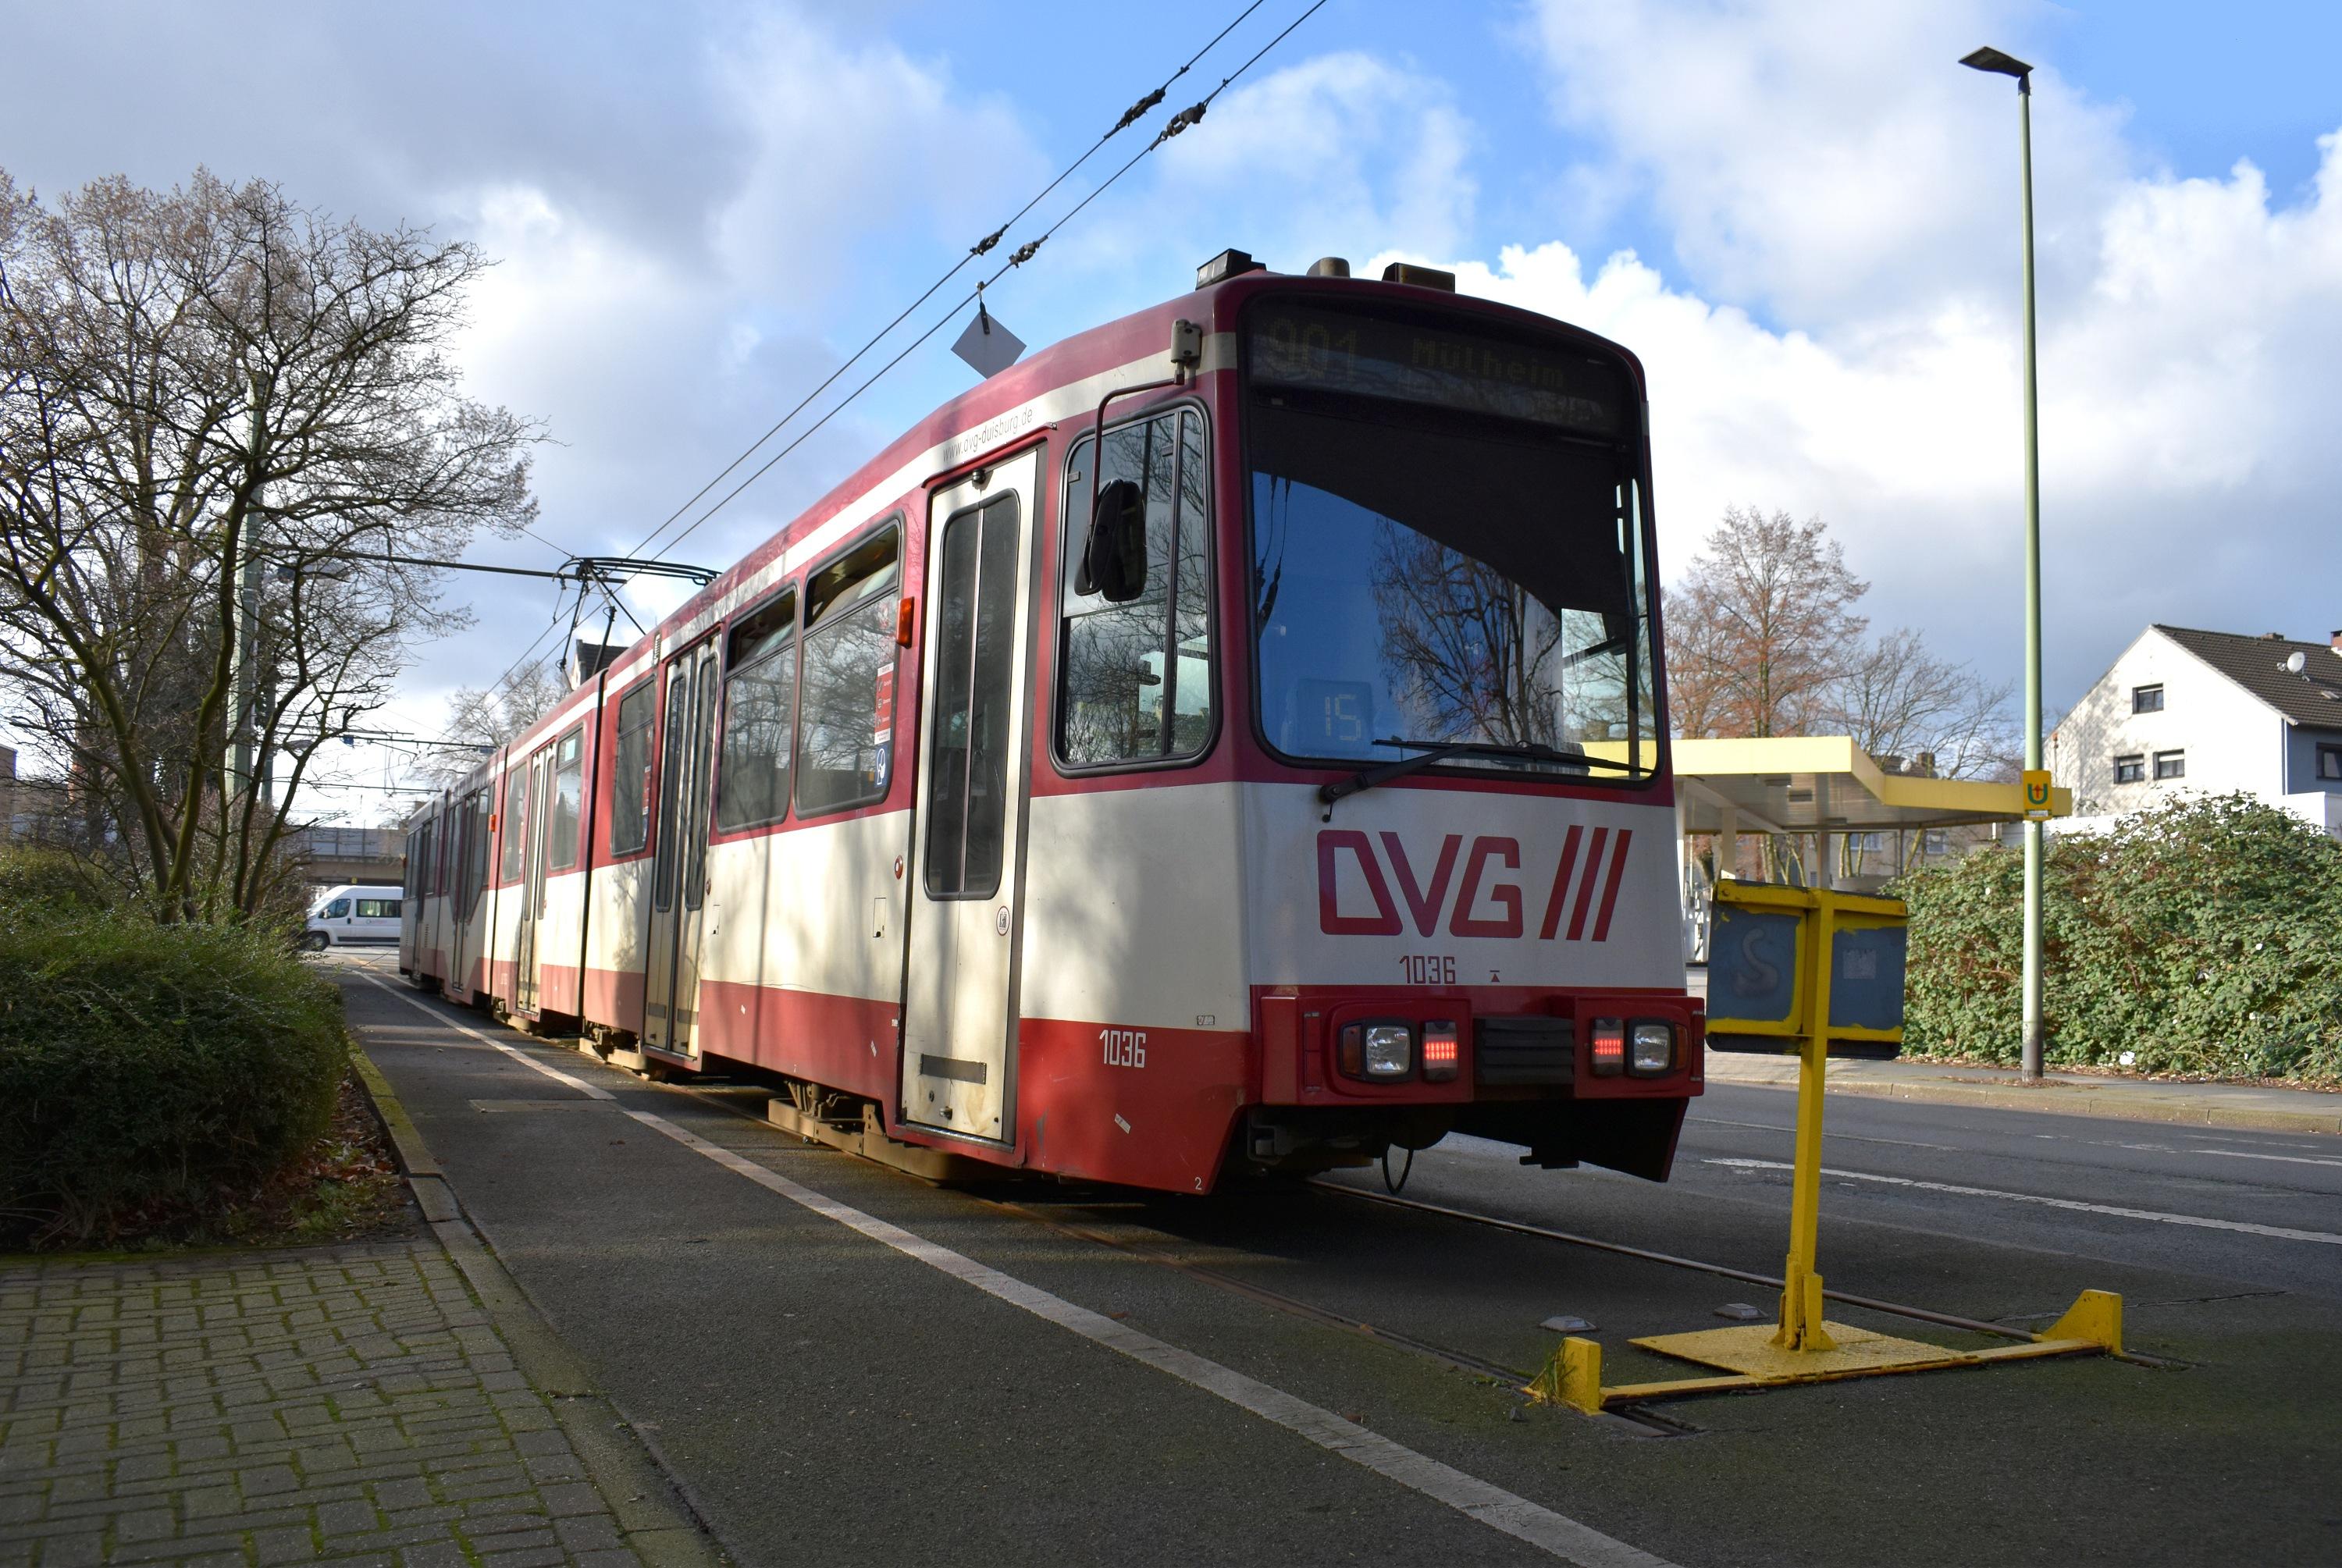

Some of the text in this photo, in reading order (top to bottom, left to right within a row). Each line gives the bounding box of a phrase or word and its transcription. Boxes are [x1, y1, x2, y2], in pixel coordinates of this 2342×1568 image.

[1268, 318, 1566, 388] 901 Mülheim
[942, 406, 1034, 463] www.dvg-duisburg.de
[1399, 955, 1457, 986] 1036
[1098, 1029, 1147, 1068] 1036
[1194, 1176, 1202, 1191] 2
